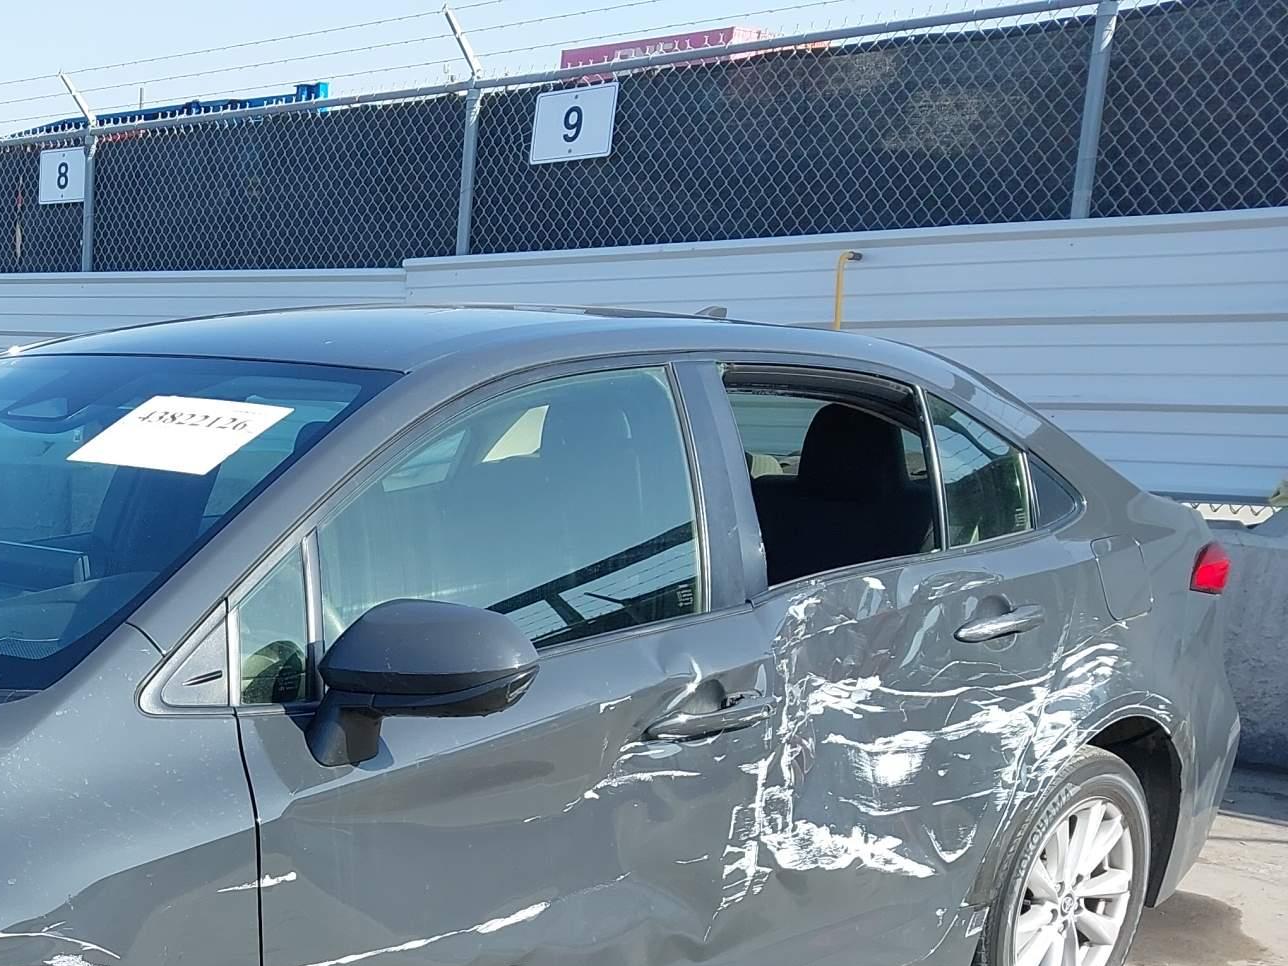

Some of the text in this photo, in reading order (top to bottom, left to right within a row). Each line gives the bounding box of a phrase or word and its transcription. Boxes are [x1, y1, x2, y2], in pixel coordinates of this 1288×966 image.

[562, 105, 583, 143] 9
[57, 161, 69, 190] 8
[137, 410, 249, 431] 43822126
[1014, 784, 1073, 881] YOKOHAMA
